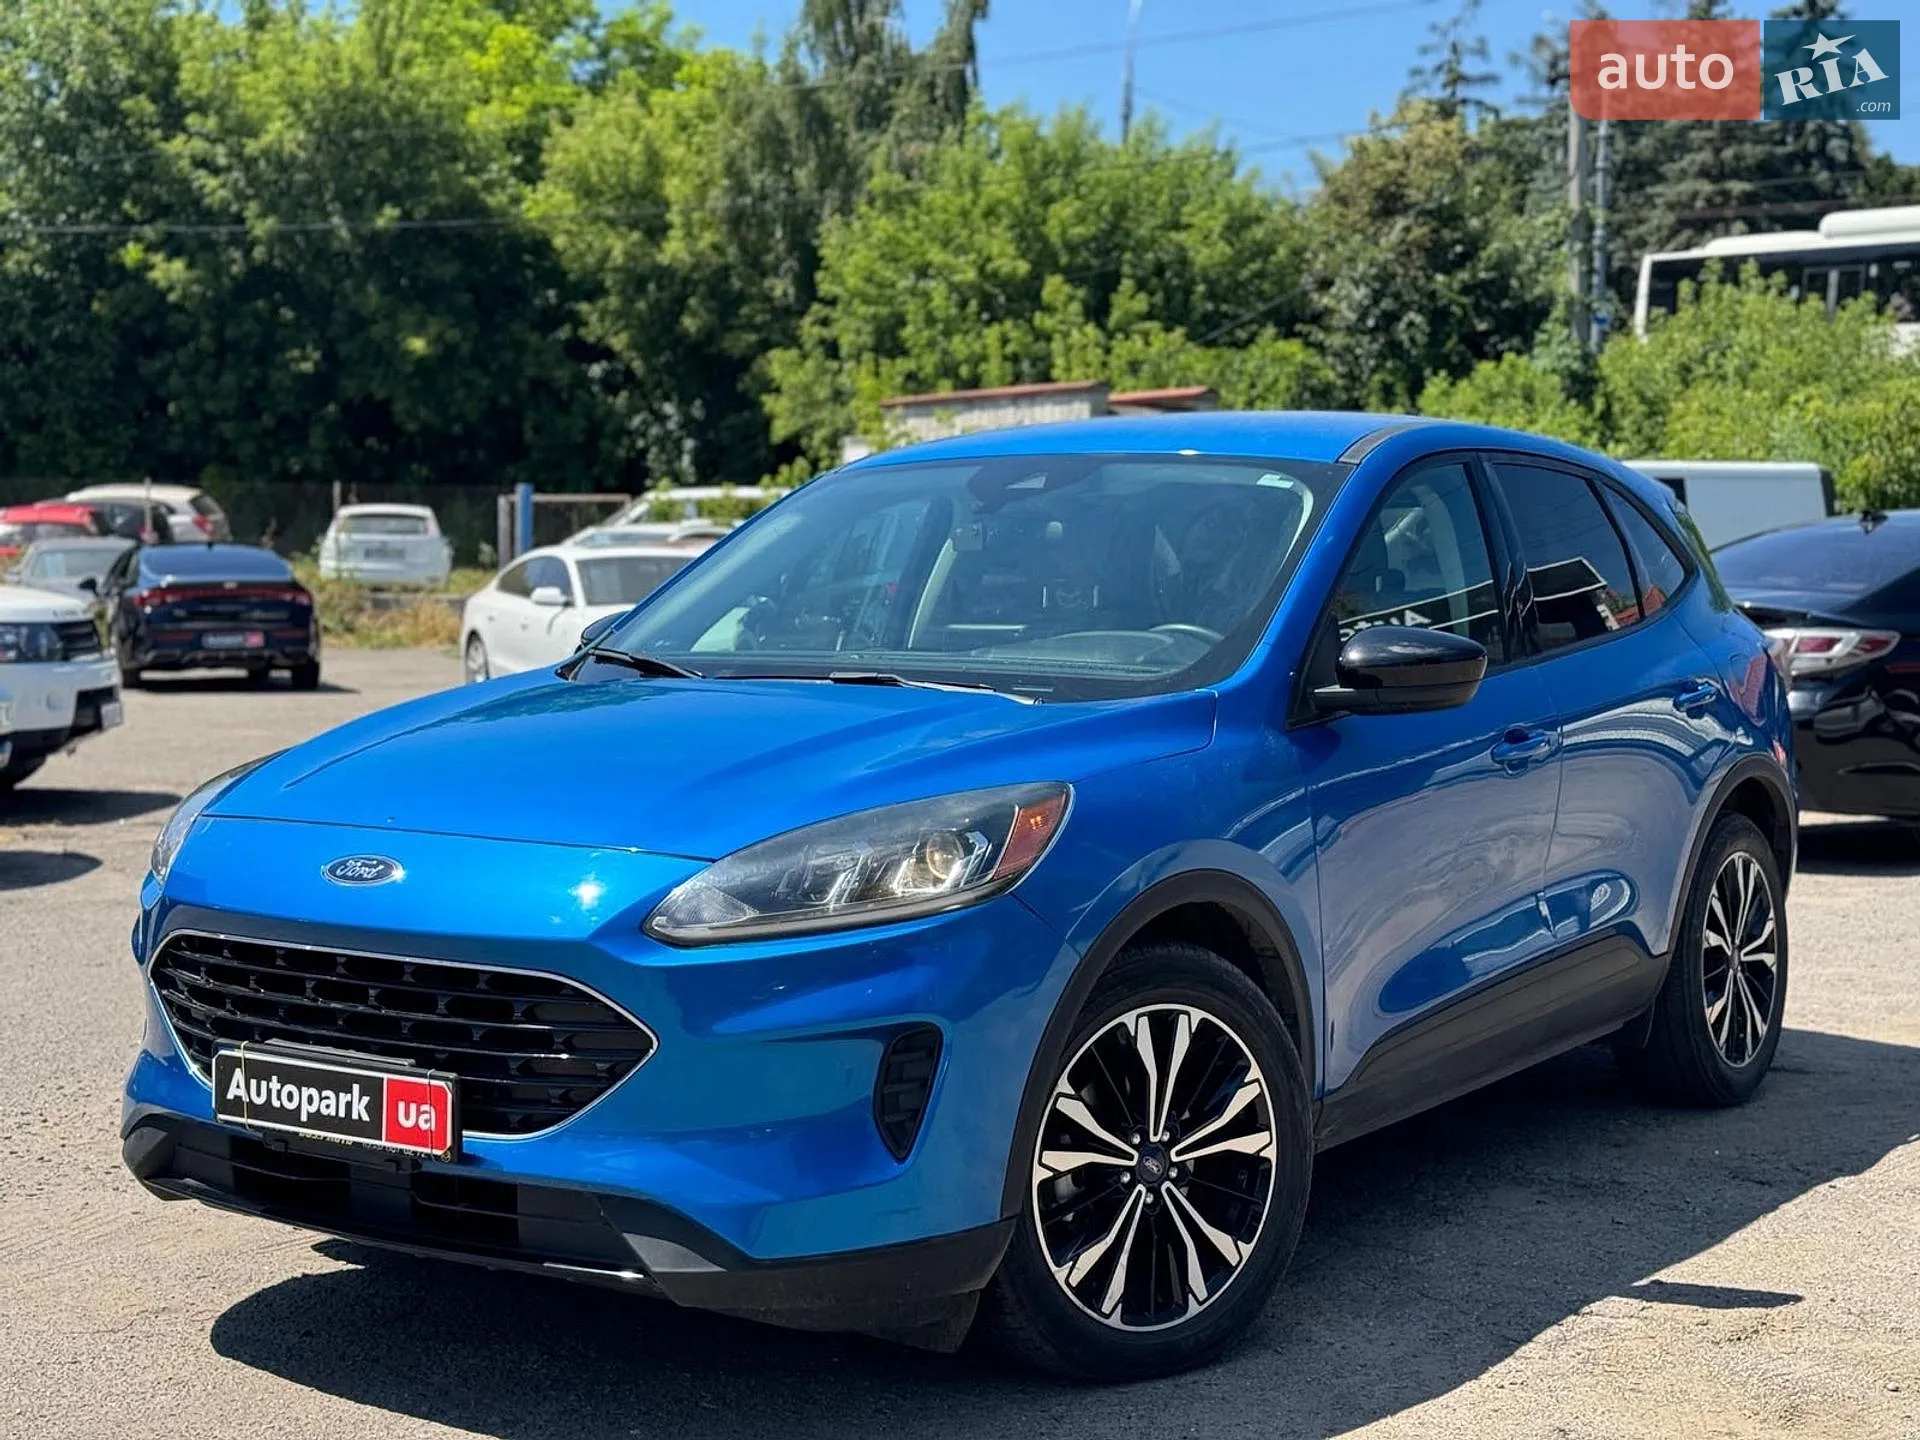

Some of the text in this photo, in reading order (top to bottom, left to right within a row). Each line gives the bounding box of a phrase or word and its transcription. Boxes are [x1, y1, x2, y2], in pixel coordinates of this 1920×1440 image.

[335, 859, 385, 879] Ford
[226, 1067, 437, 1132] Autopark ua
